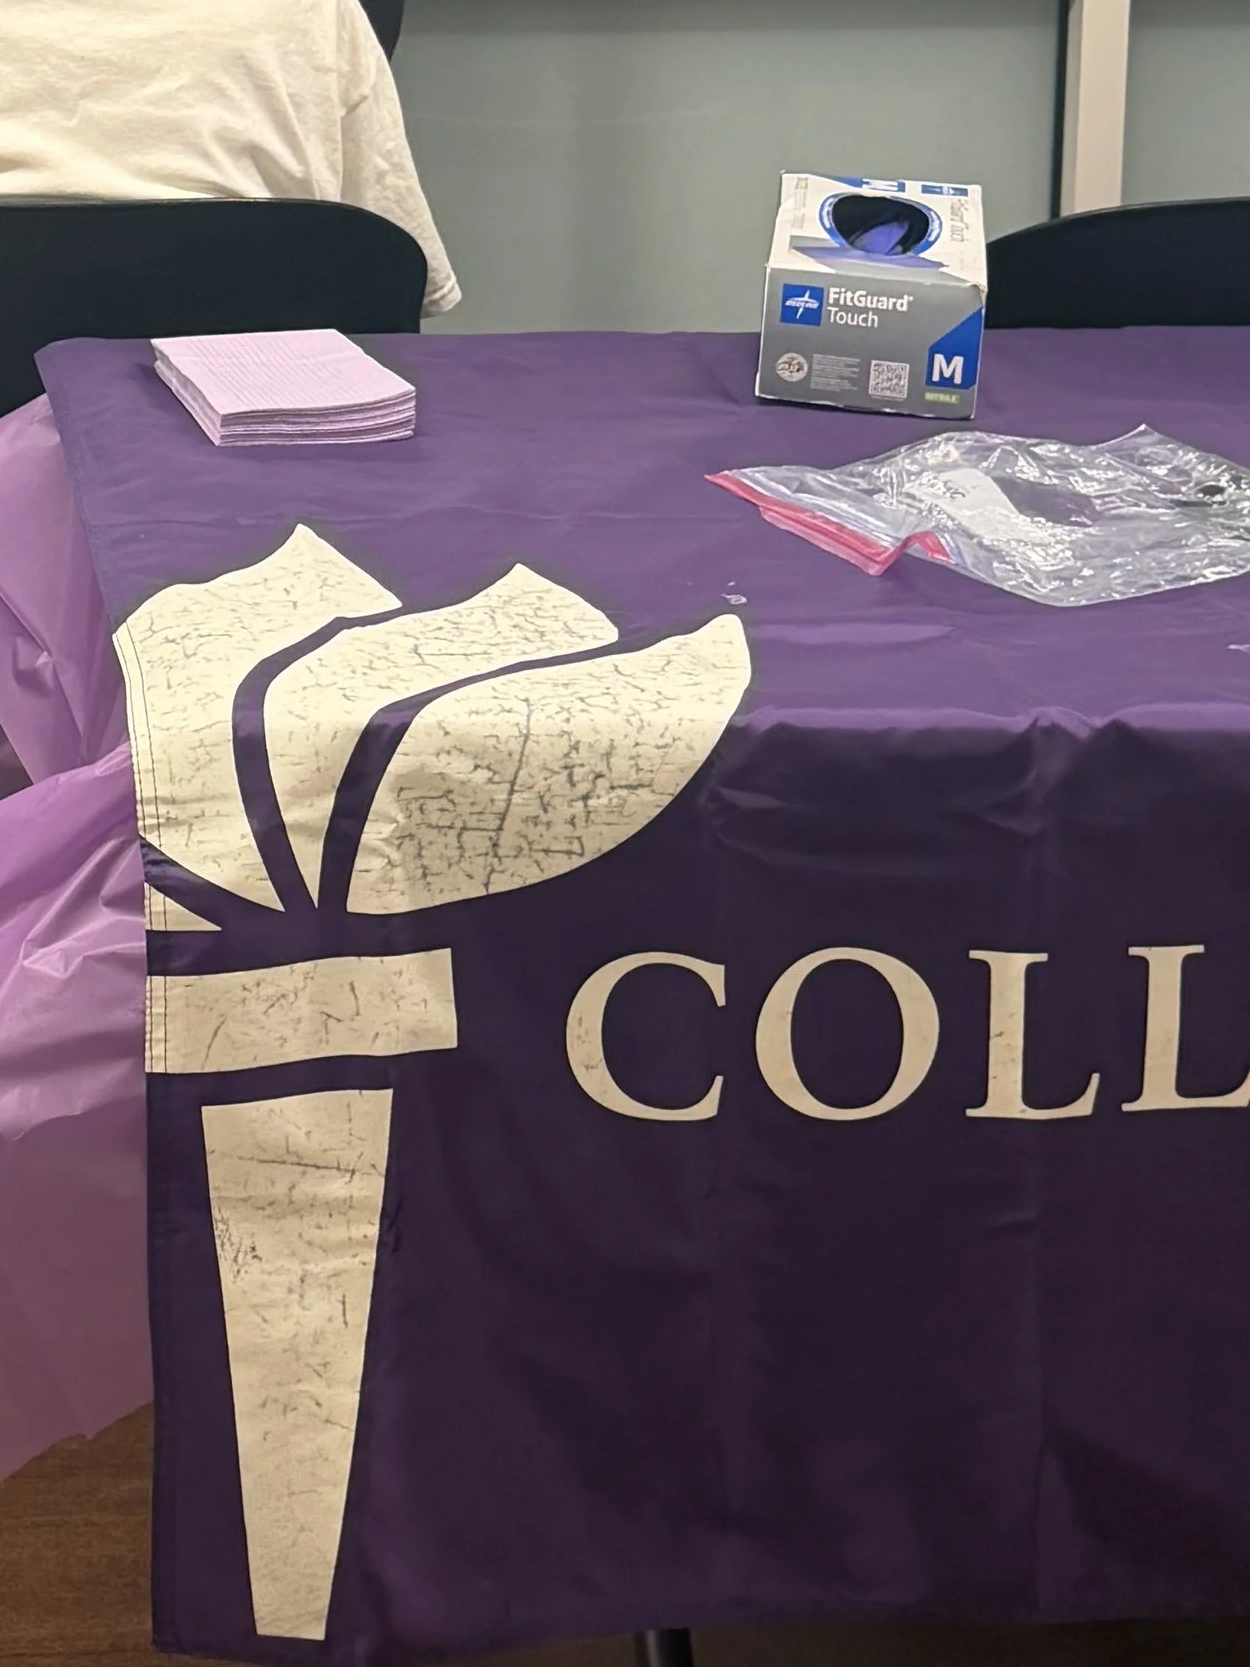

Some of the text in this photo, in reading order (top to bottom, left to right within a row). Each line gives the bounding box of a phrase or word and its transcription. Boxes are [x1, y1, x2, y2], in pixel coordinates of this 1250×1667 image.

[827, 306, 879, 328] Touch
[931, 353, 965, 385] M
[566, 945, 1250, 1121] COLL
